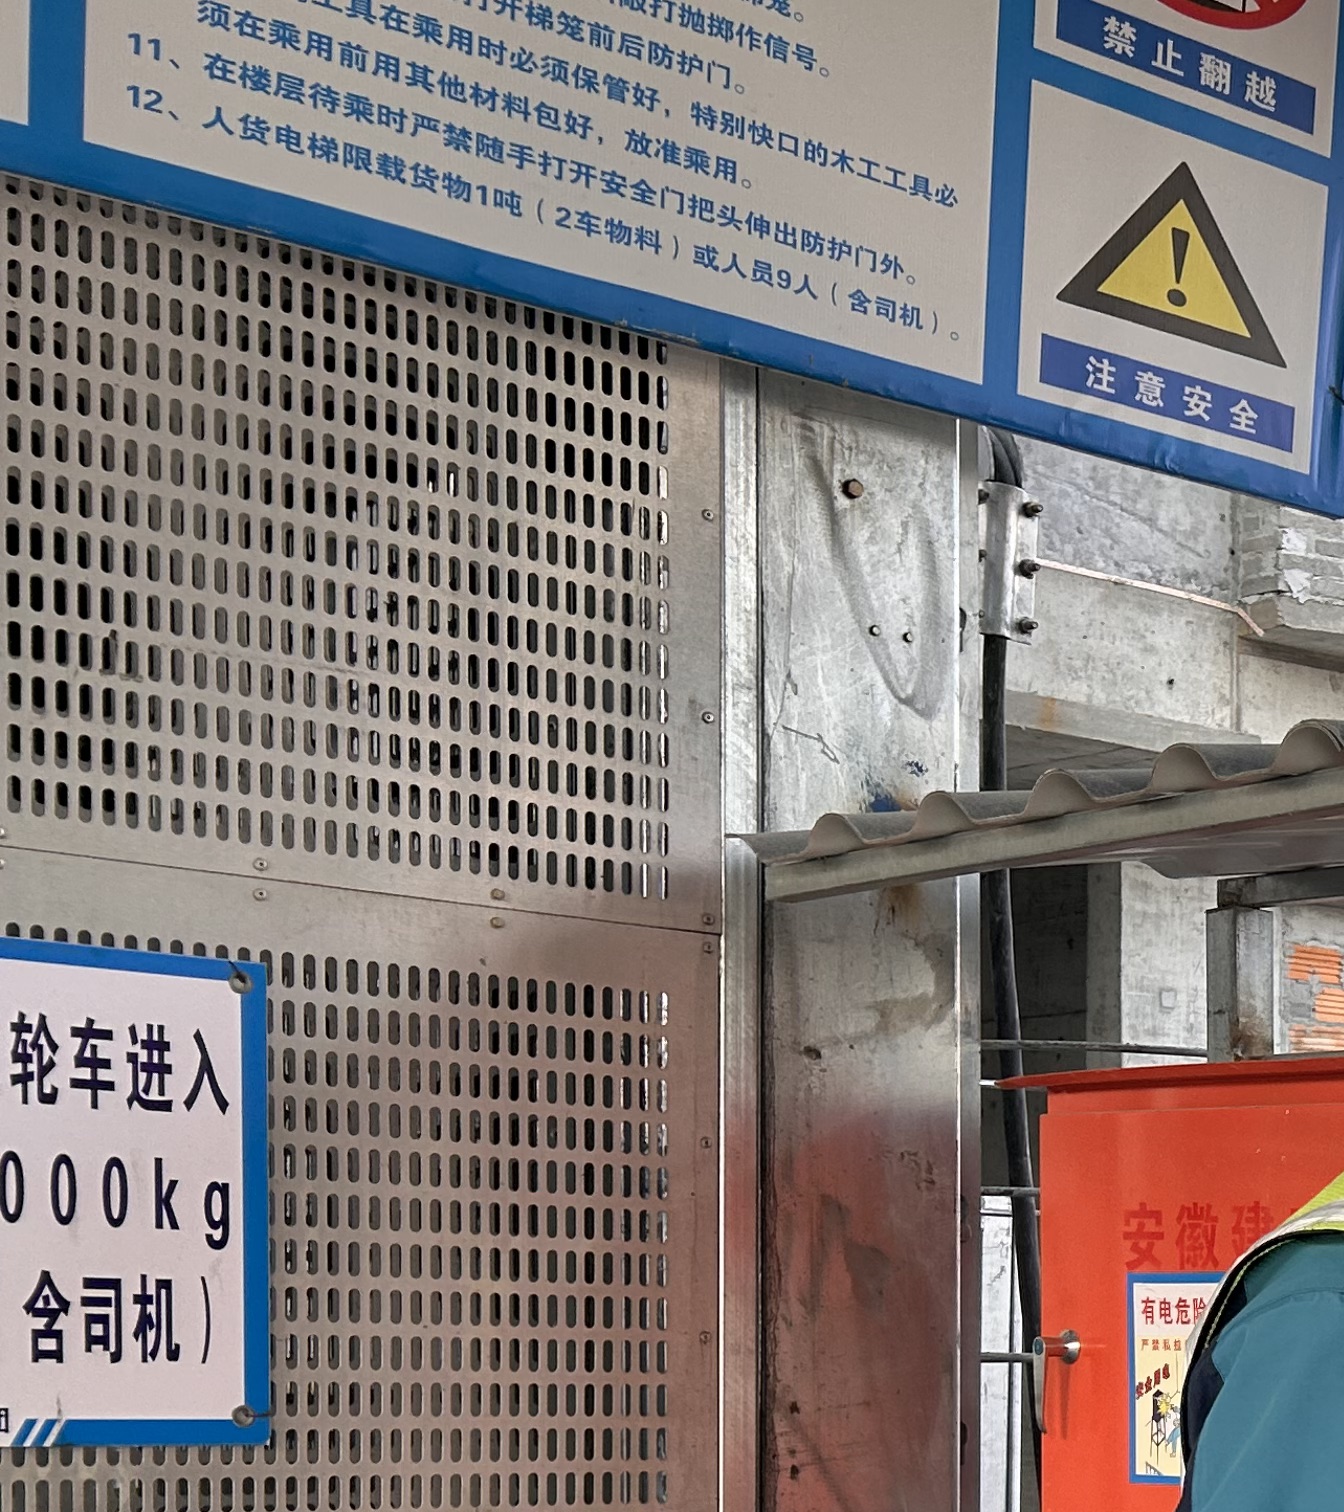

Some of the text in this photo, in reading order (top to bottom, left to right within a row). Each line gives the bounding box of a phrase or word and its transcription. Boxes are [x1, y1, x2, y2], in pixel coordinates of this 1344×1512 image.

[1103, 15, 1277, 113] 禁止翻越
[1086, 355, 1260, 435] 注意安全
[10, 1011, 230, 1115] 轮车进入
[1122, 1201, 1300, 1270] 安徽建
